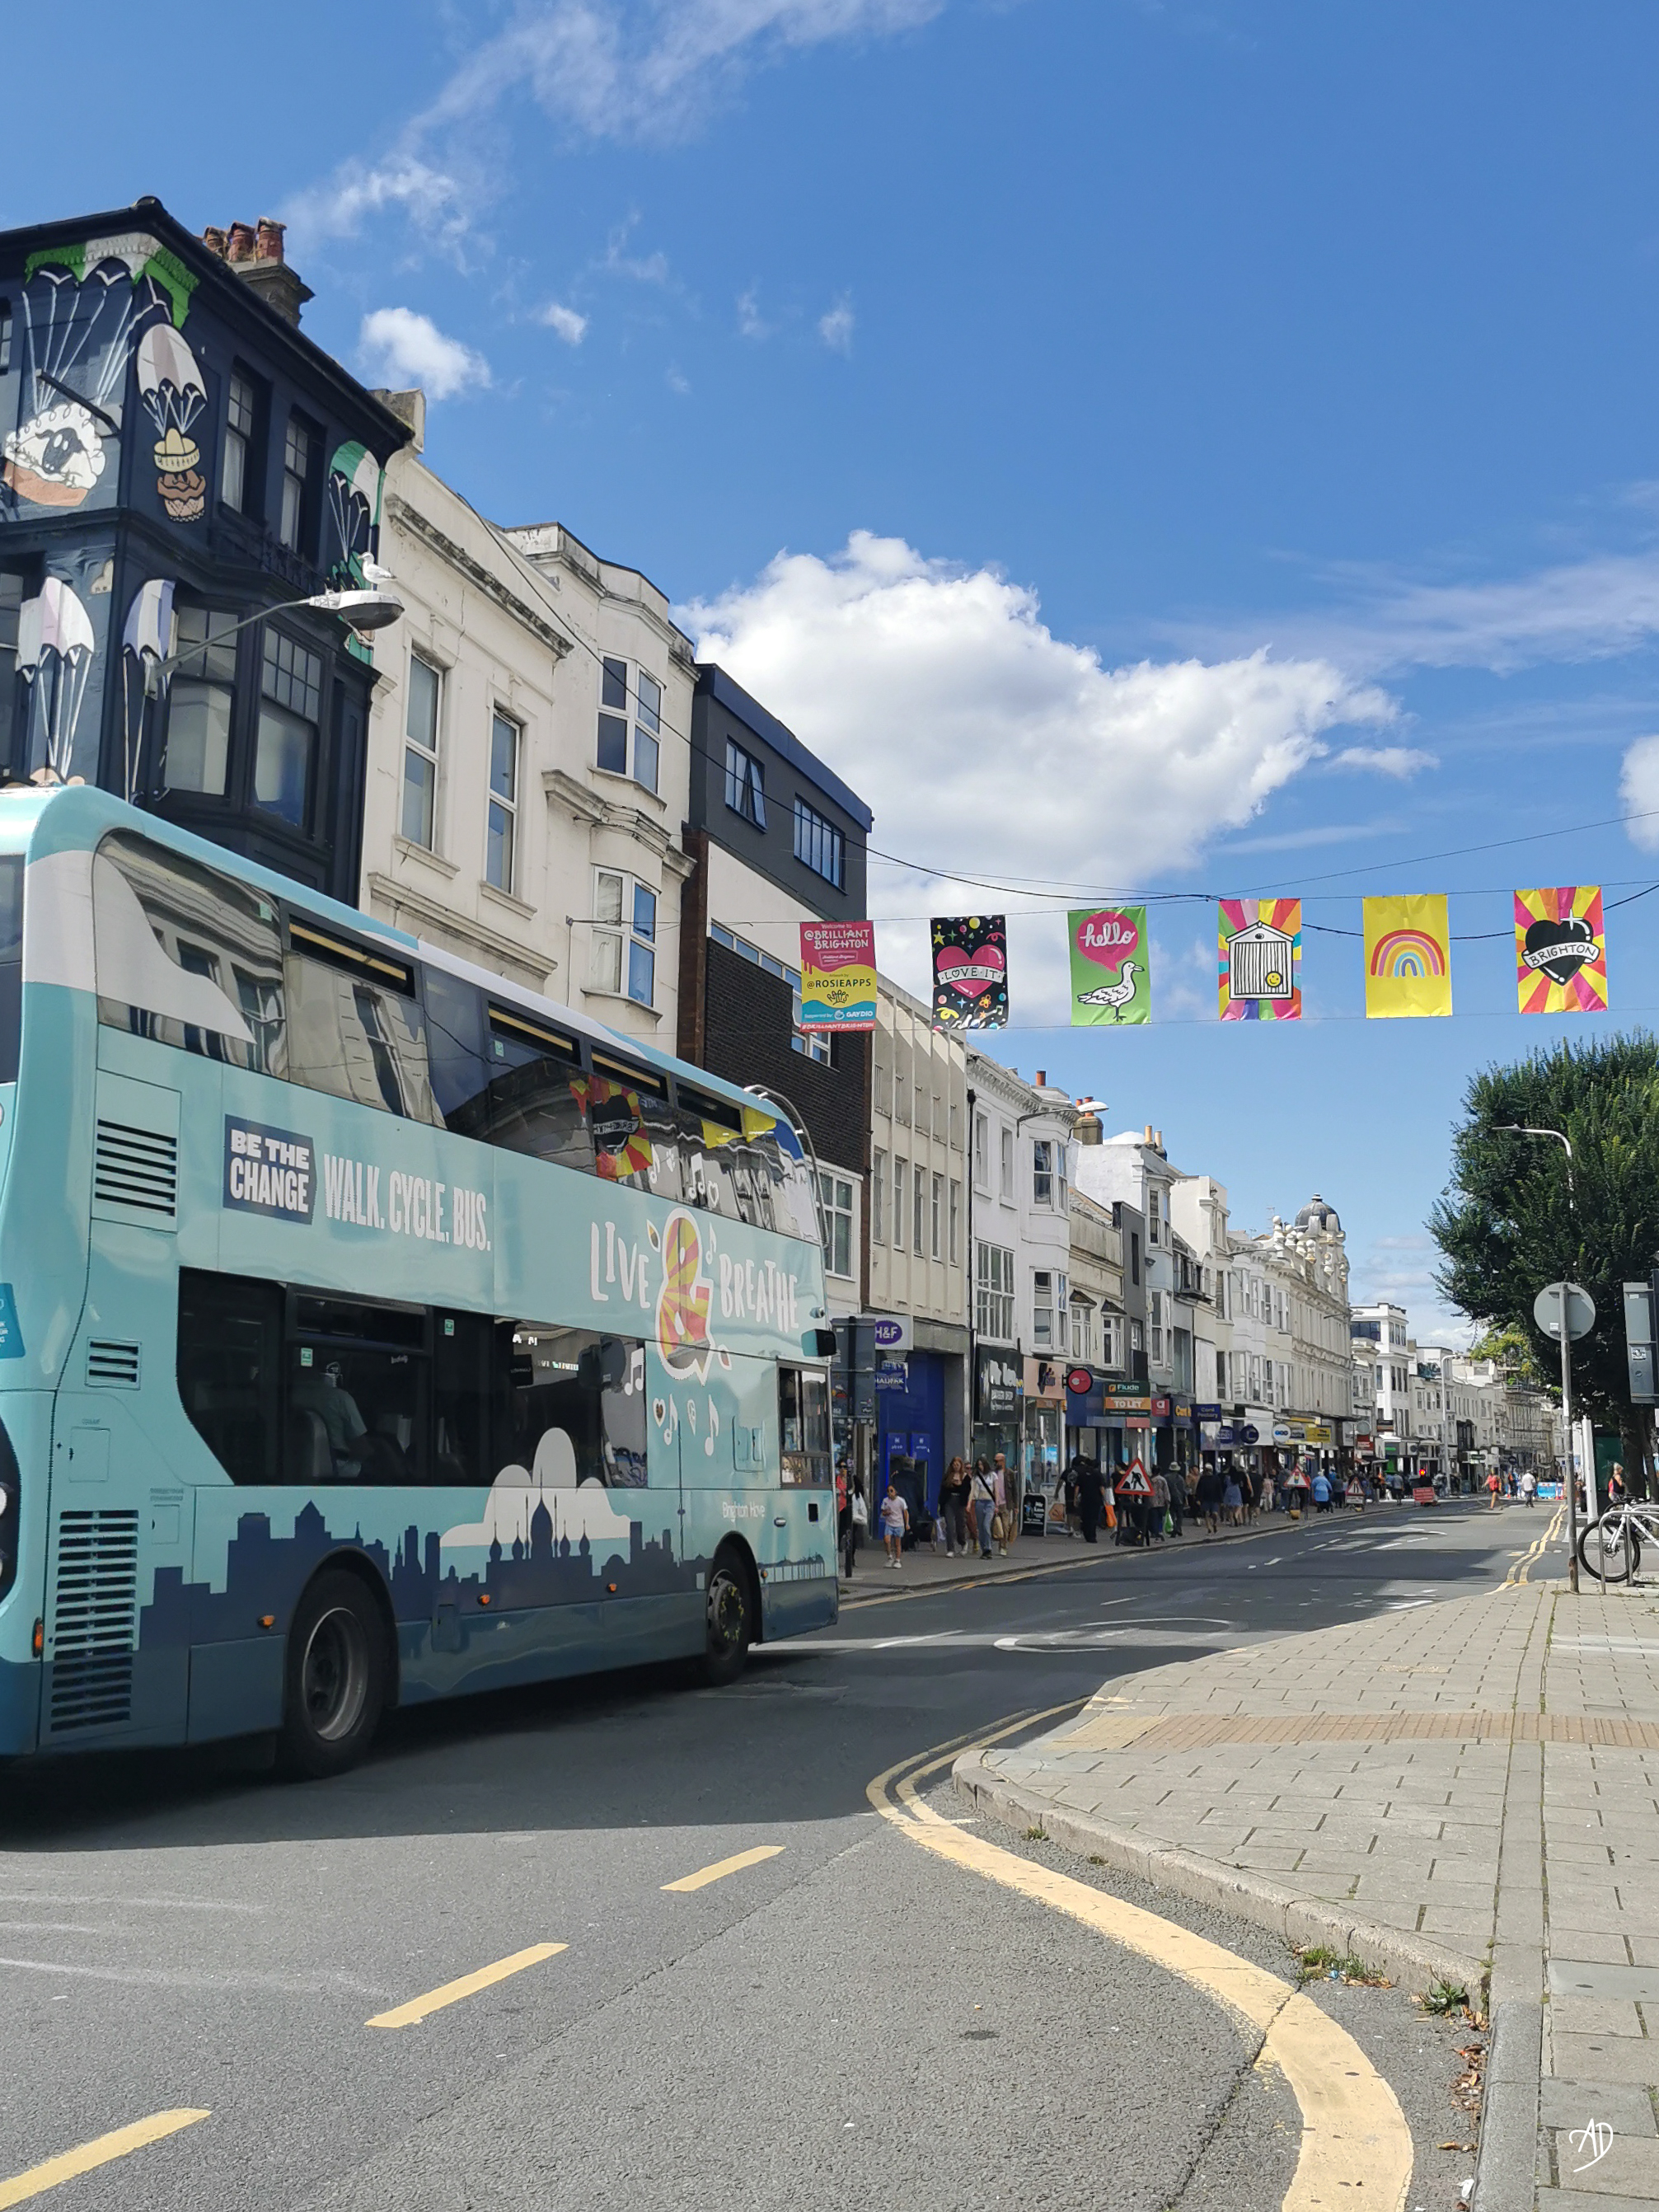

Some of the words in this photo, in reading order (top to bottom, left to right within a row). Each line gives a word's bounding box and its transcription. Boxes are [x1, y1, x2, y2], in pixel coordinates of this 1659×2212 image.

[804, 929, 870, 941] @BRILLIANT
[1080, 921, 1136, 949] hello
[813, 939, 869, 950] BRIGHTON
[1530, 943, 1597, 967] BRIGHTON
[944, 967, 978, 980] LOVE
[984, 968, 998, 980] IT
[806, 977, 872, 990] @ROSIEAPPS
[846, 1010, 874, 1019] GAYDIO
[231, 1128, 262, 1158] BE
[265, 1138, 310, 1170] THE
[230, 1157, 310, 1213] CHANGE
[324, 1153, 386, 1230] WALK.
[389, 1170, 450, 1244] CYCLE.
[452, 1186, 492, 1252] BUS.
[591, 1221, 651, 1310] LIVE
[719, 1252, 799, 1333] BREATHE
[1117, 1383, 1140, 1391] Flude
[1113, 1400, 1126, 1408] TO
[1127, 1400, 1142, 1408] LET
